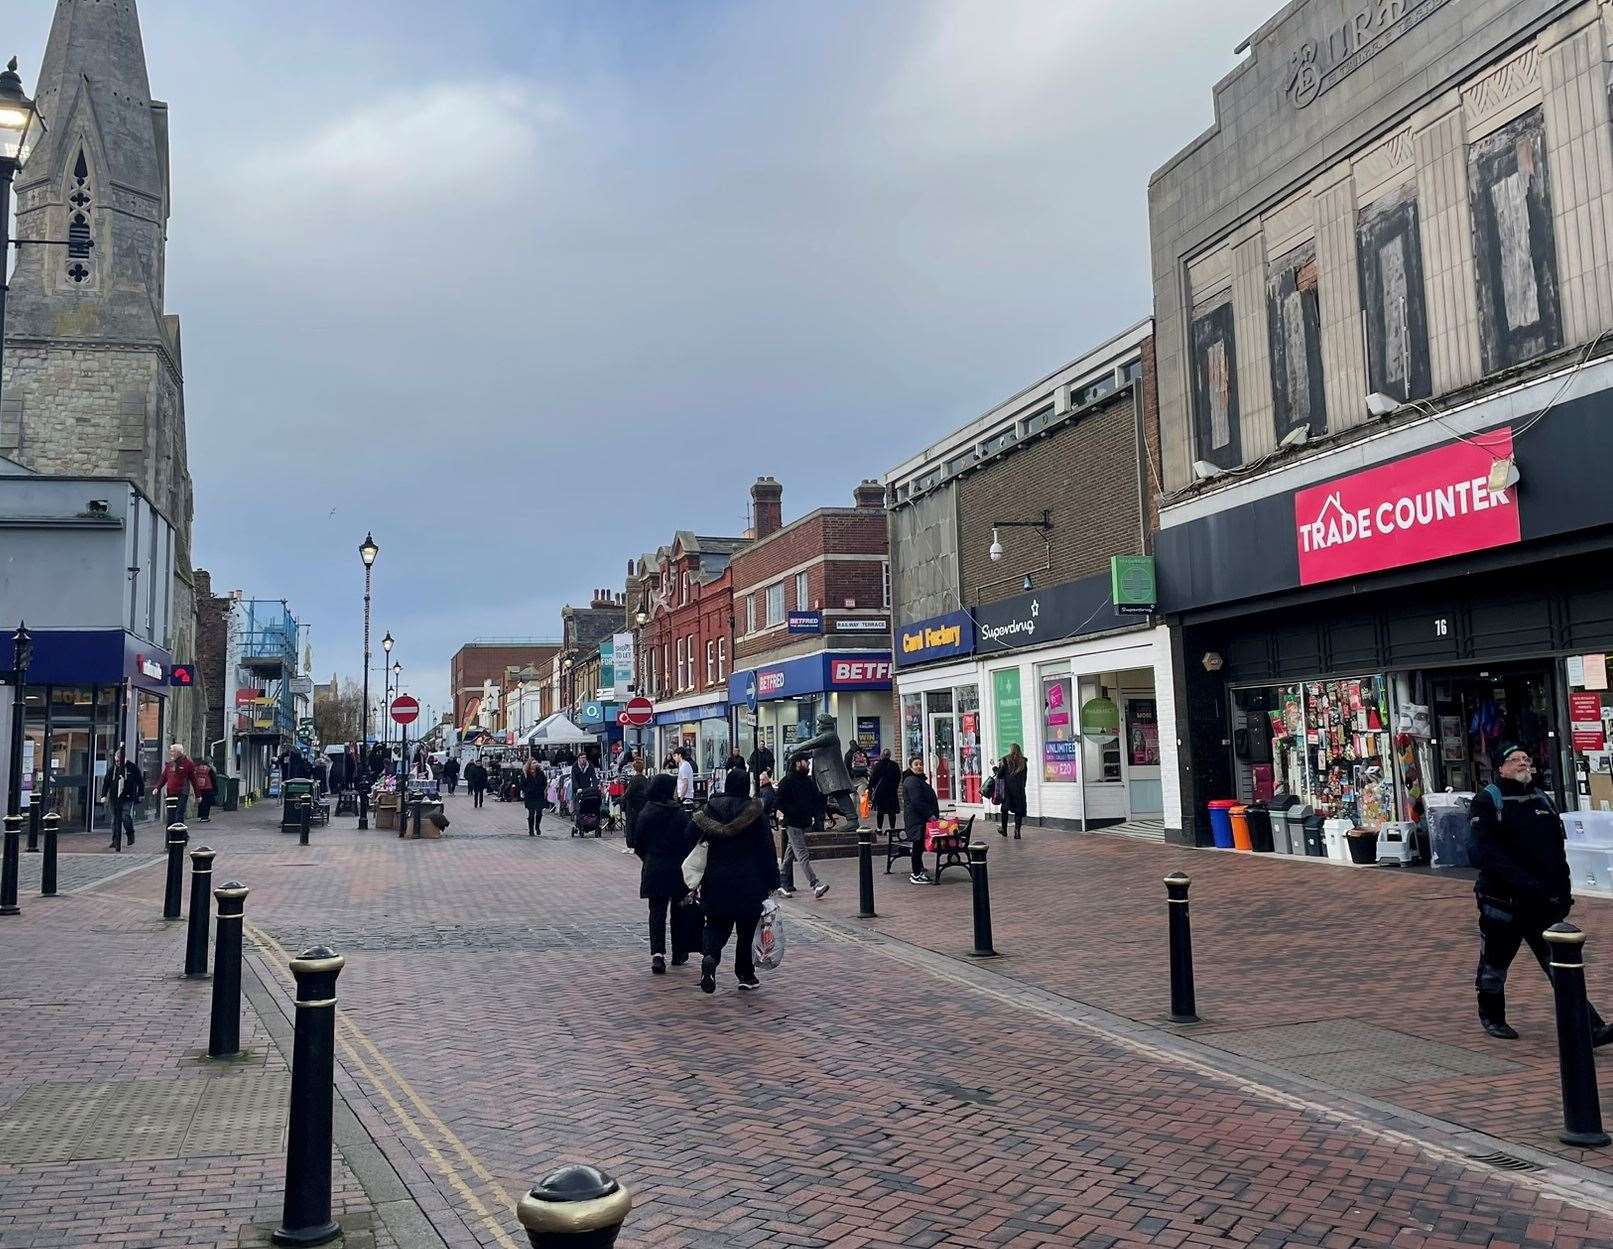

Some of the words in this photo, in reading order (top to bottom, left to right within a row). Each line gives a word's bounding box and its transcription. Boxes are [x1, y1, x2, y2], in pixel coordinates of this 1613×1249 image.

[1300, 508, 1373, 553] TRADE
[789, 617, 819, 625] BETFRED
[981, 619, 1036, 641] Superdrug
[902, 630, 923, 653] Card
[925, 624, 961, 648] Factory
